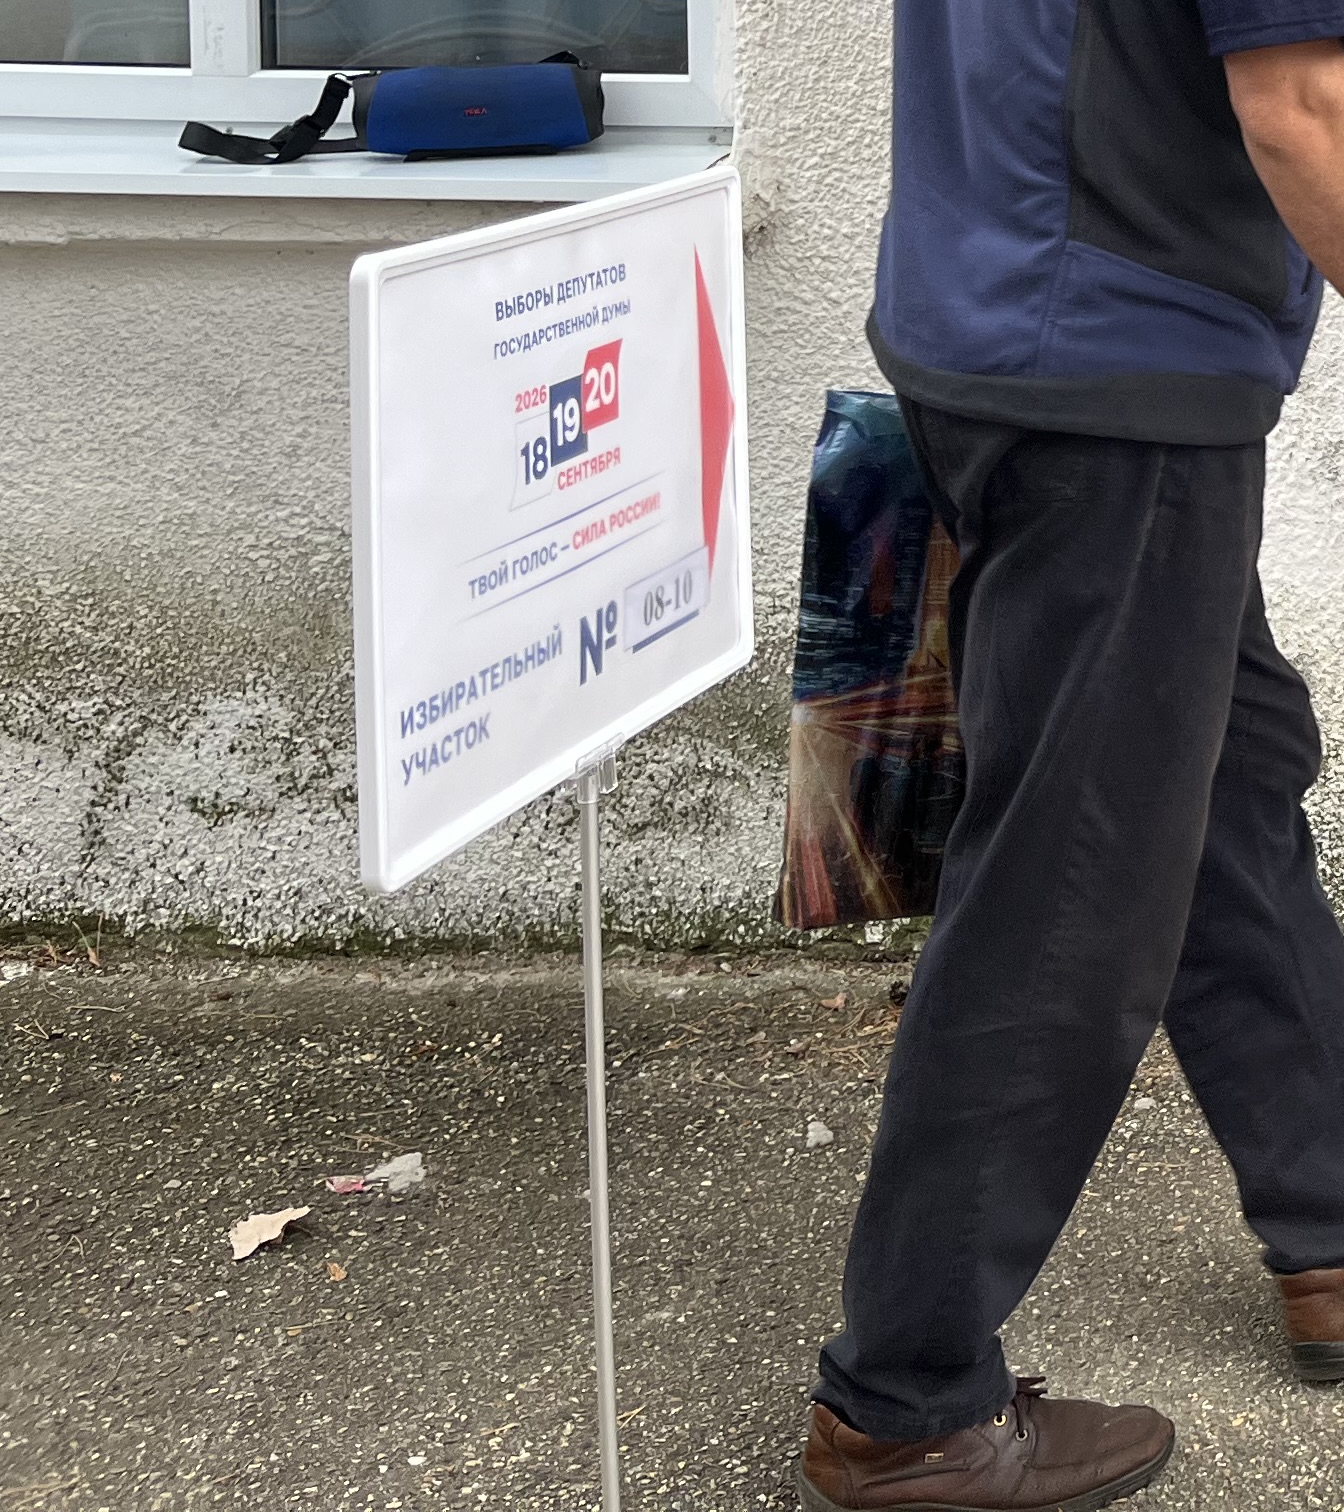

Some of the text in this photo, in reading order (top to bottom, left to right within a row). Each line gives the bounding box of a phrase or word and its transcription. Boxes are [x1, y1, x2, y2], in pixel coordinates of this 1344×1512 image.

[493, 299, 631, 360] ГОСУДАРСТВЕННОЙ ДУМЫ
[495, 263, 626, 322] ВЫБОРЫ ДЕПУТАТОВ
[514, 384, 548, 413] 2026
[520, 361, 616, 485] 18 19 20
[557, 446, 622, 491] СЕНТЯБРЯ
[468, 560, 509, 599] ТВОЙ
[512, 541, 558, 580] ГОЛОС
[572, 521, 607, 550] СИЛА
[609, 491, 662, 534] РОССИИ!
[579, 568, 694, 687] № 08-10
[400, 622, 564, 740] ИЗБИРАТЕЛЬНЫЙ
[400, 711, 492, 788] УЧАСТОК
